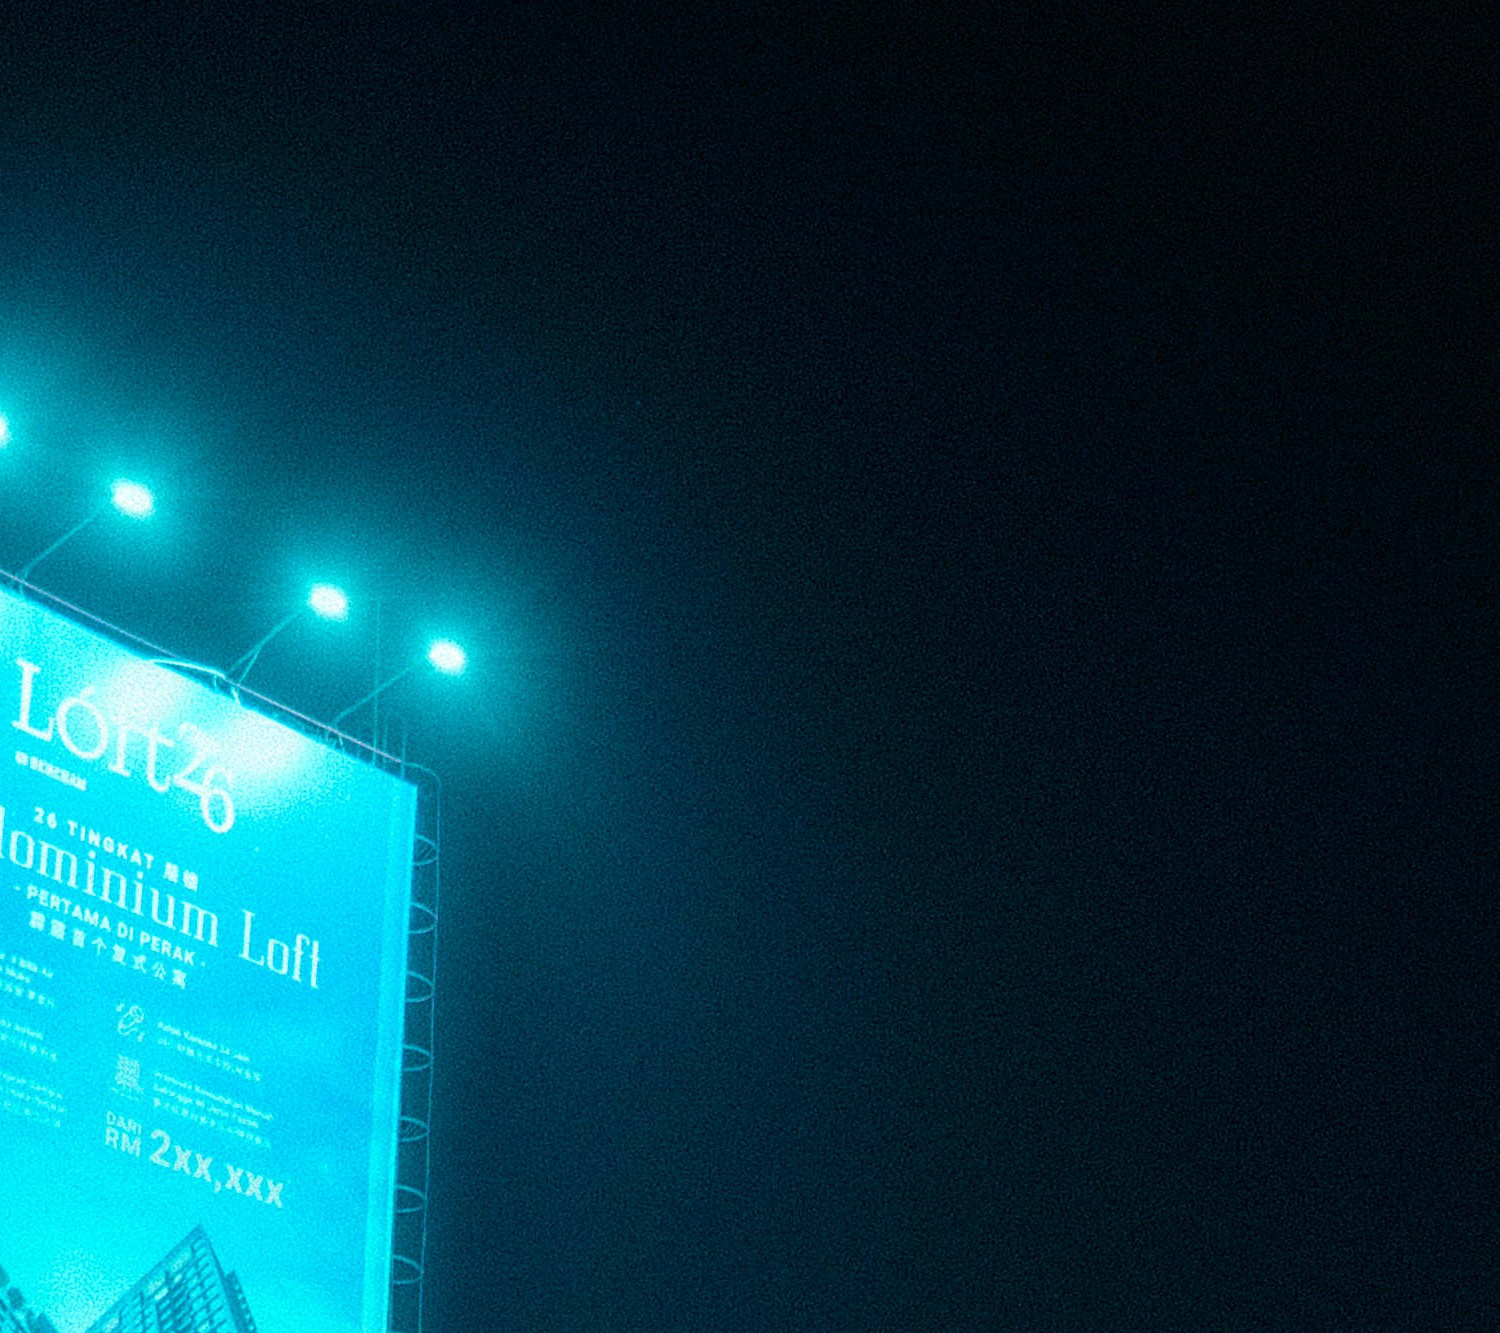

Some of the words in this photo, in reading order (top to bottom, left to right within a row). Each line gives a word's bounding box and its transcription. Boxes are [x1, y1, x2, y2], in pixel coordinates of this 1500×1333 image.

[33, 806, 58, 830] 26
[67, 820, 155, 870] TINGKAT
[26, 883, 111, 932] PERTAMA
[117, 921, 134, 942] DI
[139, 931, 196, 967] PERAK
[238, 908, 321, 990] Loft
[104, 1126, 142, 1158] RM
[105, 1109, 142, 1136] DARI
